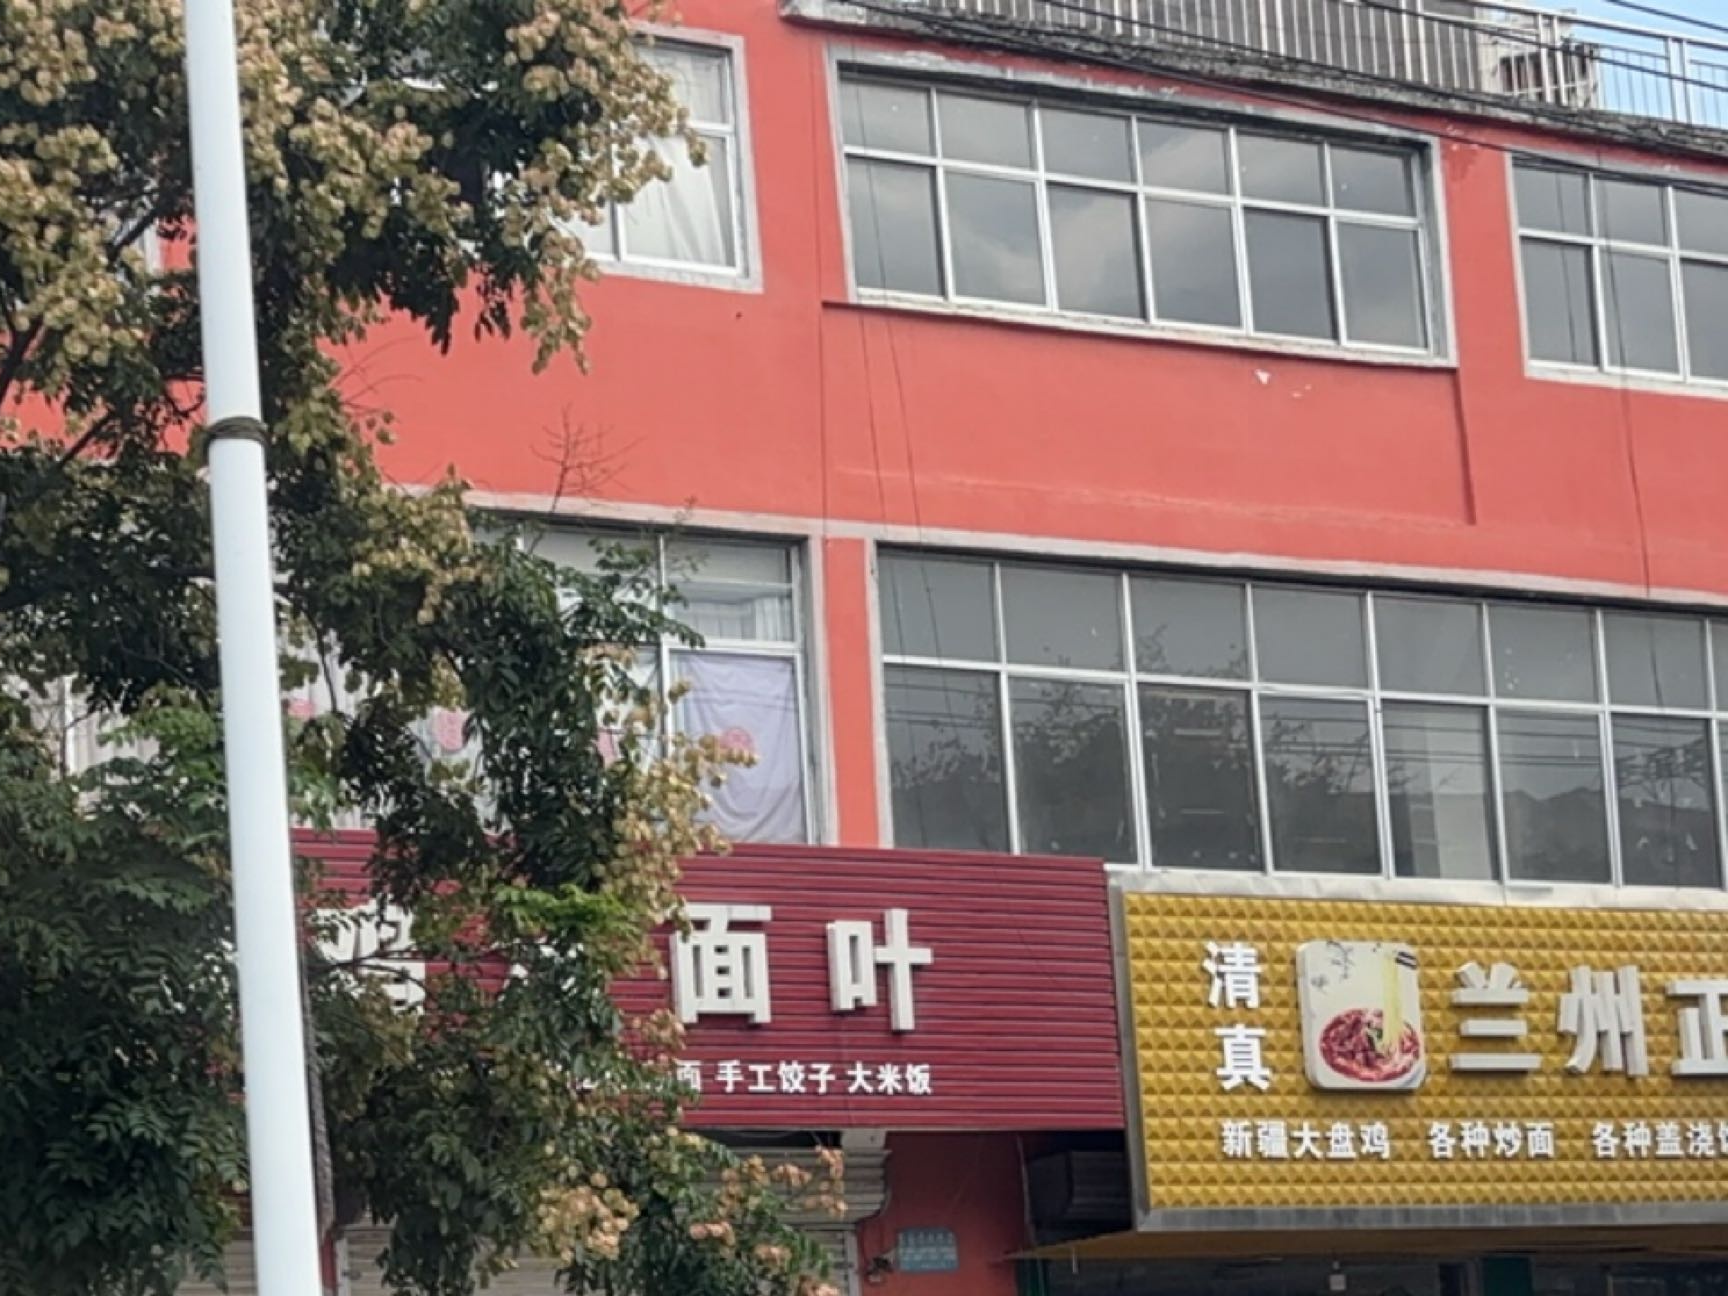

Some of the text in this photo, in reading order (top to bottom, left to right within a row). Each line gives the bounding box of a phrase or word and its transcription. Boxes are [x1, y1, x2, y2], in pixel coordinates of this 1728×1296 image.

[1202, 941, 1270, 1091] 清真
[715, 1060, 837, 1094] 手工饺子
[846, 1062, 934, 1095] 大米饭
[1221, 1119, 1391, 1160] 新疆大盘鸡
[1428, 1120, 1556, 1160] 各种炒面
